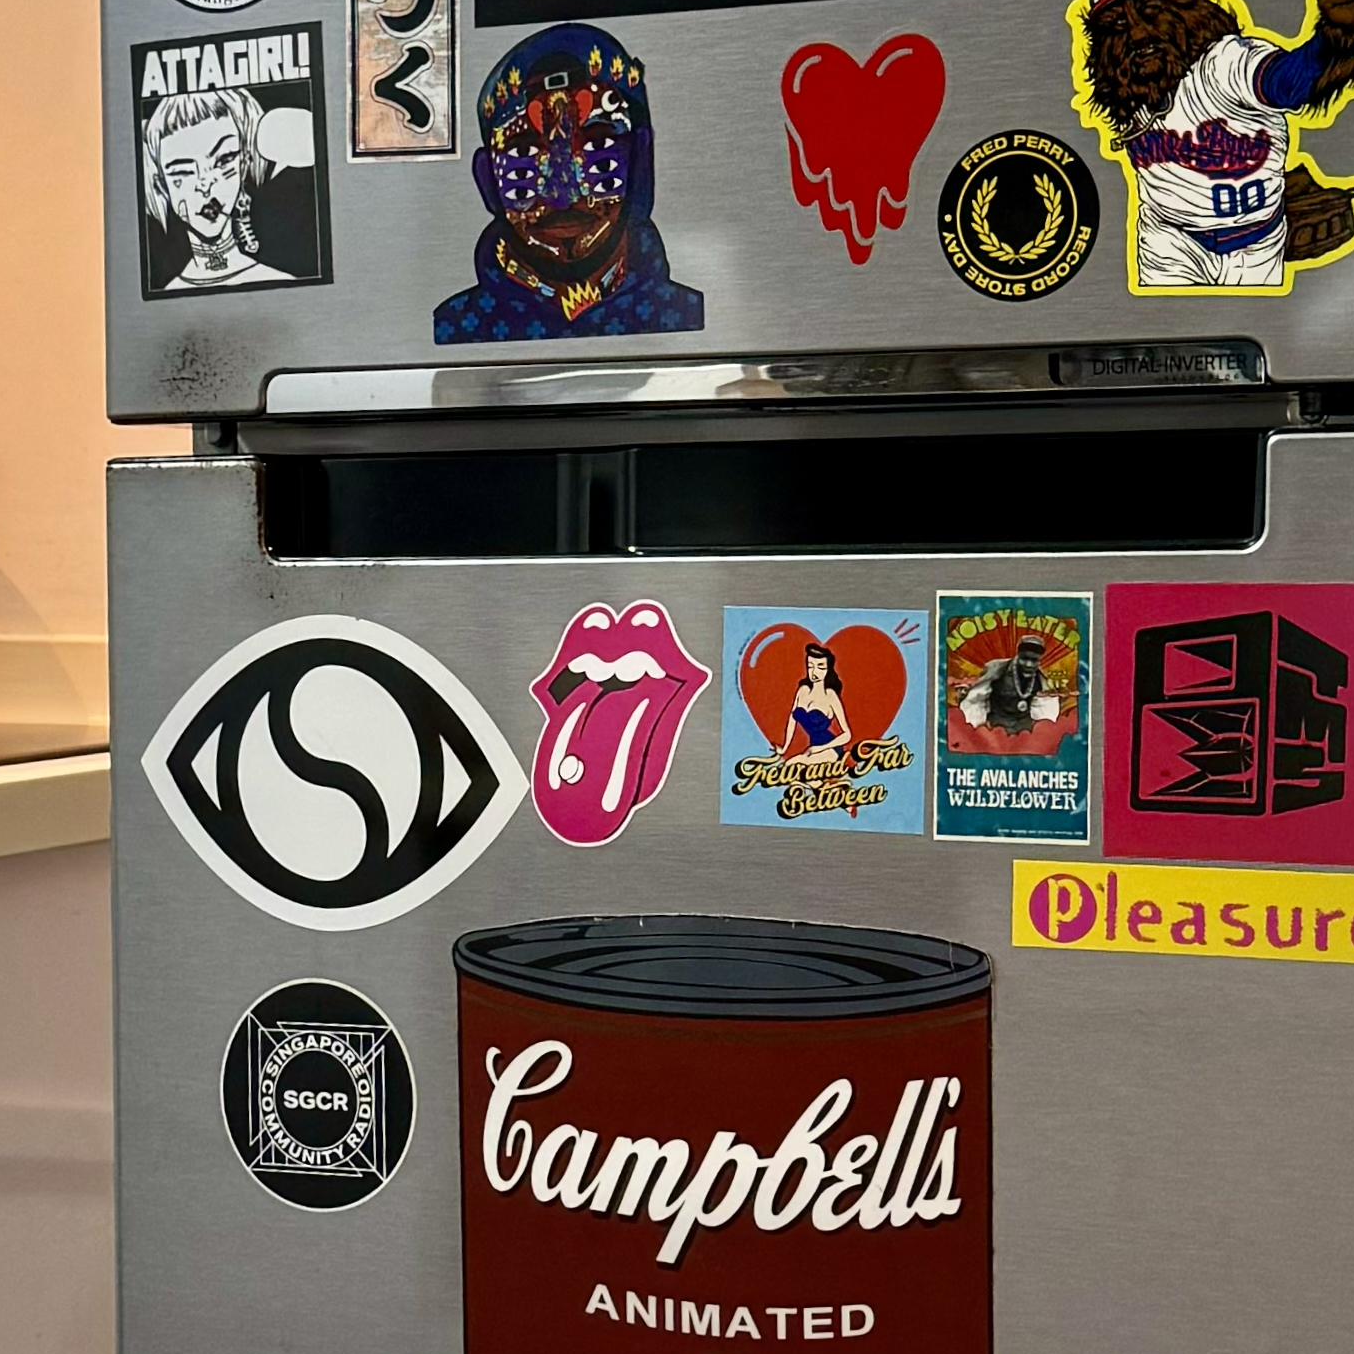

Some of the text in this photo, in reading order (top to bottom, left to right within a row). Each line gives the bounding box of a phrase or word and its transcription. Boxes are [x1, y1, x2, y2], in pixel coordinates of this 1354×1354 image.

[141, 32, 310, 97] ATTAGIRL!
[961, 134, 1074, 171] FRED PERRY
[1211, 178, 1265, 218] 00
[942, 225, 1092, 296] RECORD STORE DAY
[1093, 353, 1247, 375] DIGITAL INVERTER
[946, 609, 1081, 651] NOISY EATER
[732, 735, 914, 794] Few and Far
[947, 768, 1079, 790] THE AVALANCHES
[778, 781, 888, 819] Between
[947, 788, 1077, 811] WILDFLOWER
[266, 1034, 366, 1079] SINGAPORE
[283, 1089, 348, 1111] SGCR
[262, 1078, 371, 1165] COMMUNITY RADIO
[483, 1039, 961, 1264] Campbell's
[585, 1283, 875, 1341] ANIMATED
